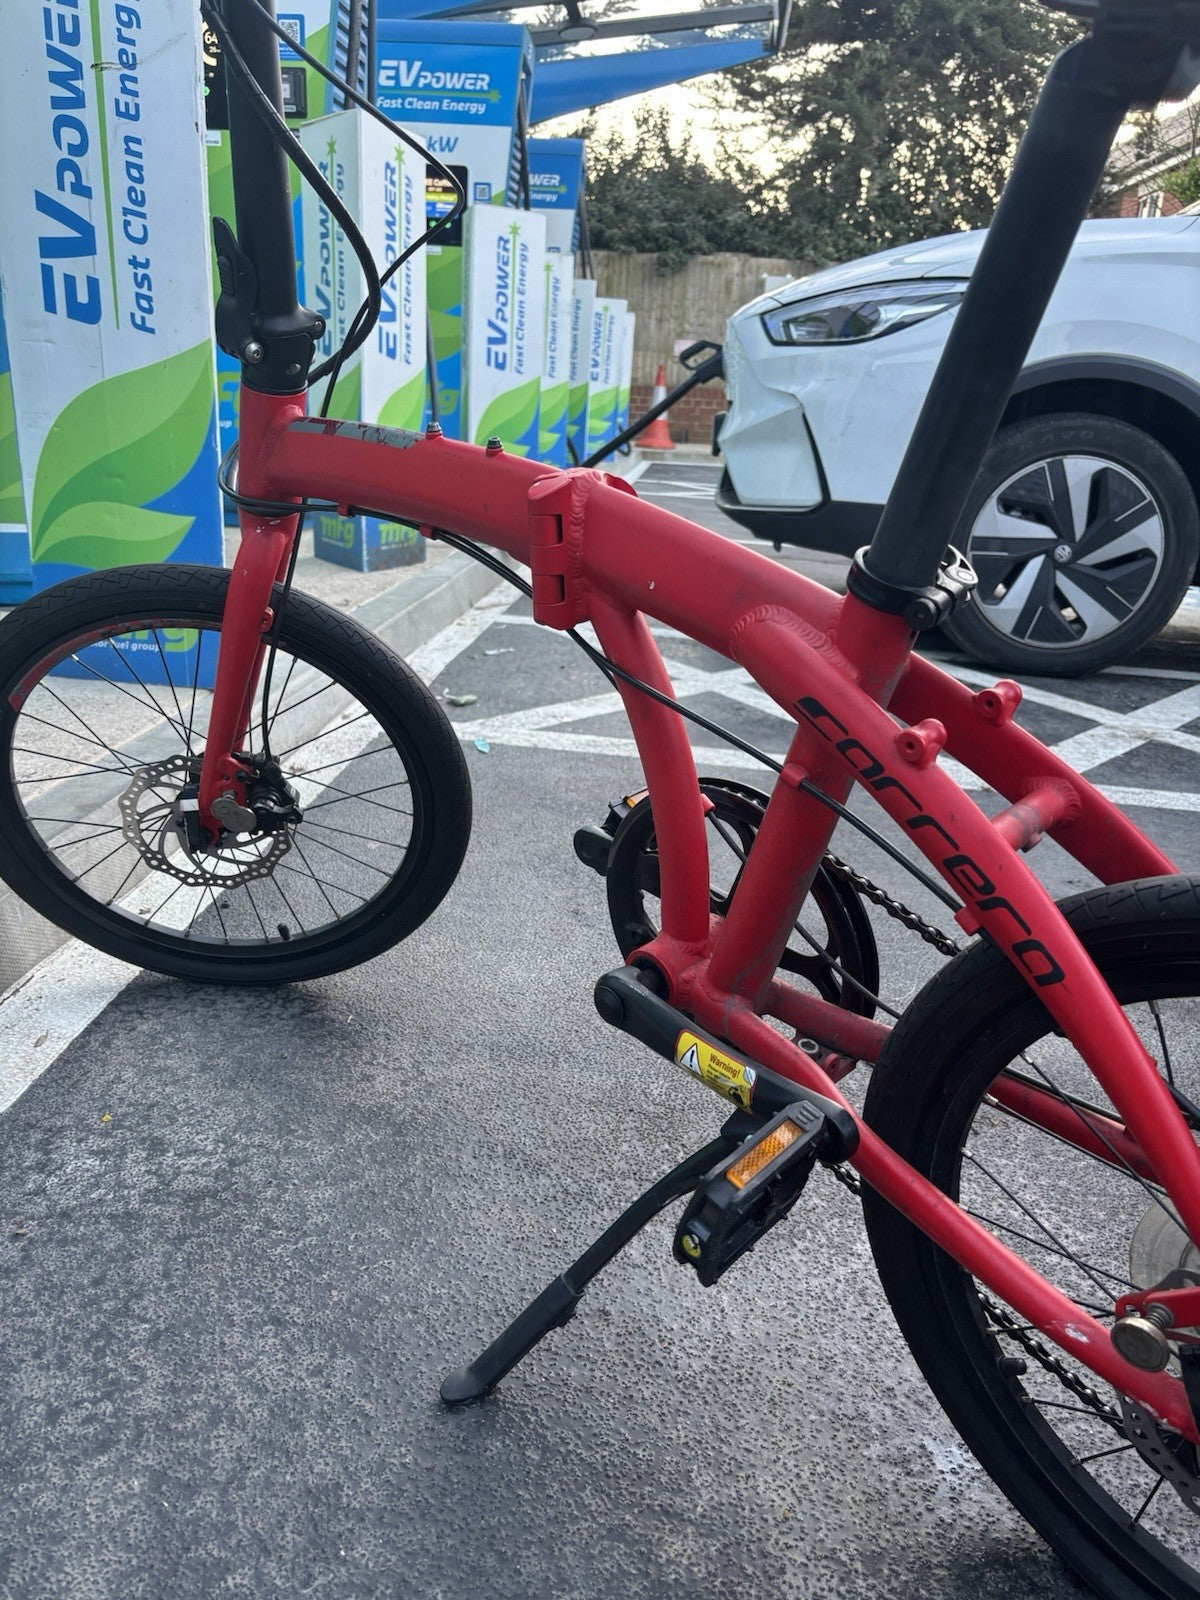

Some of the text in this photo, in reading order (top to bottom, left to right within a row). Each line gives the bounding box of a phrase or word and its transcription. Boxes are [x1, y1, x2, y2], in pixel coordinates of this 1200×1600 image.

[376, 97, 487, 115] Fast Clean Energy
[113, 0, 156, 335] Fast Clean Energ
[337, 250, 346, 311] Clean
[514, 242, 529, 375] Fast Clean Energy
[403, 320, 412, 366] Fast
[708, 1053, 741, 1078] Warning!
